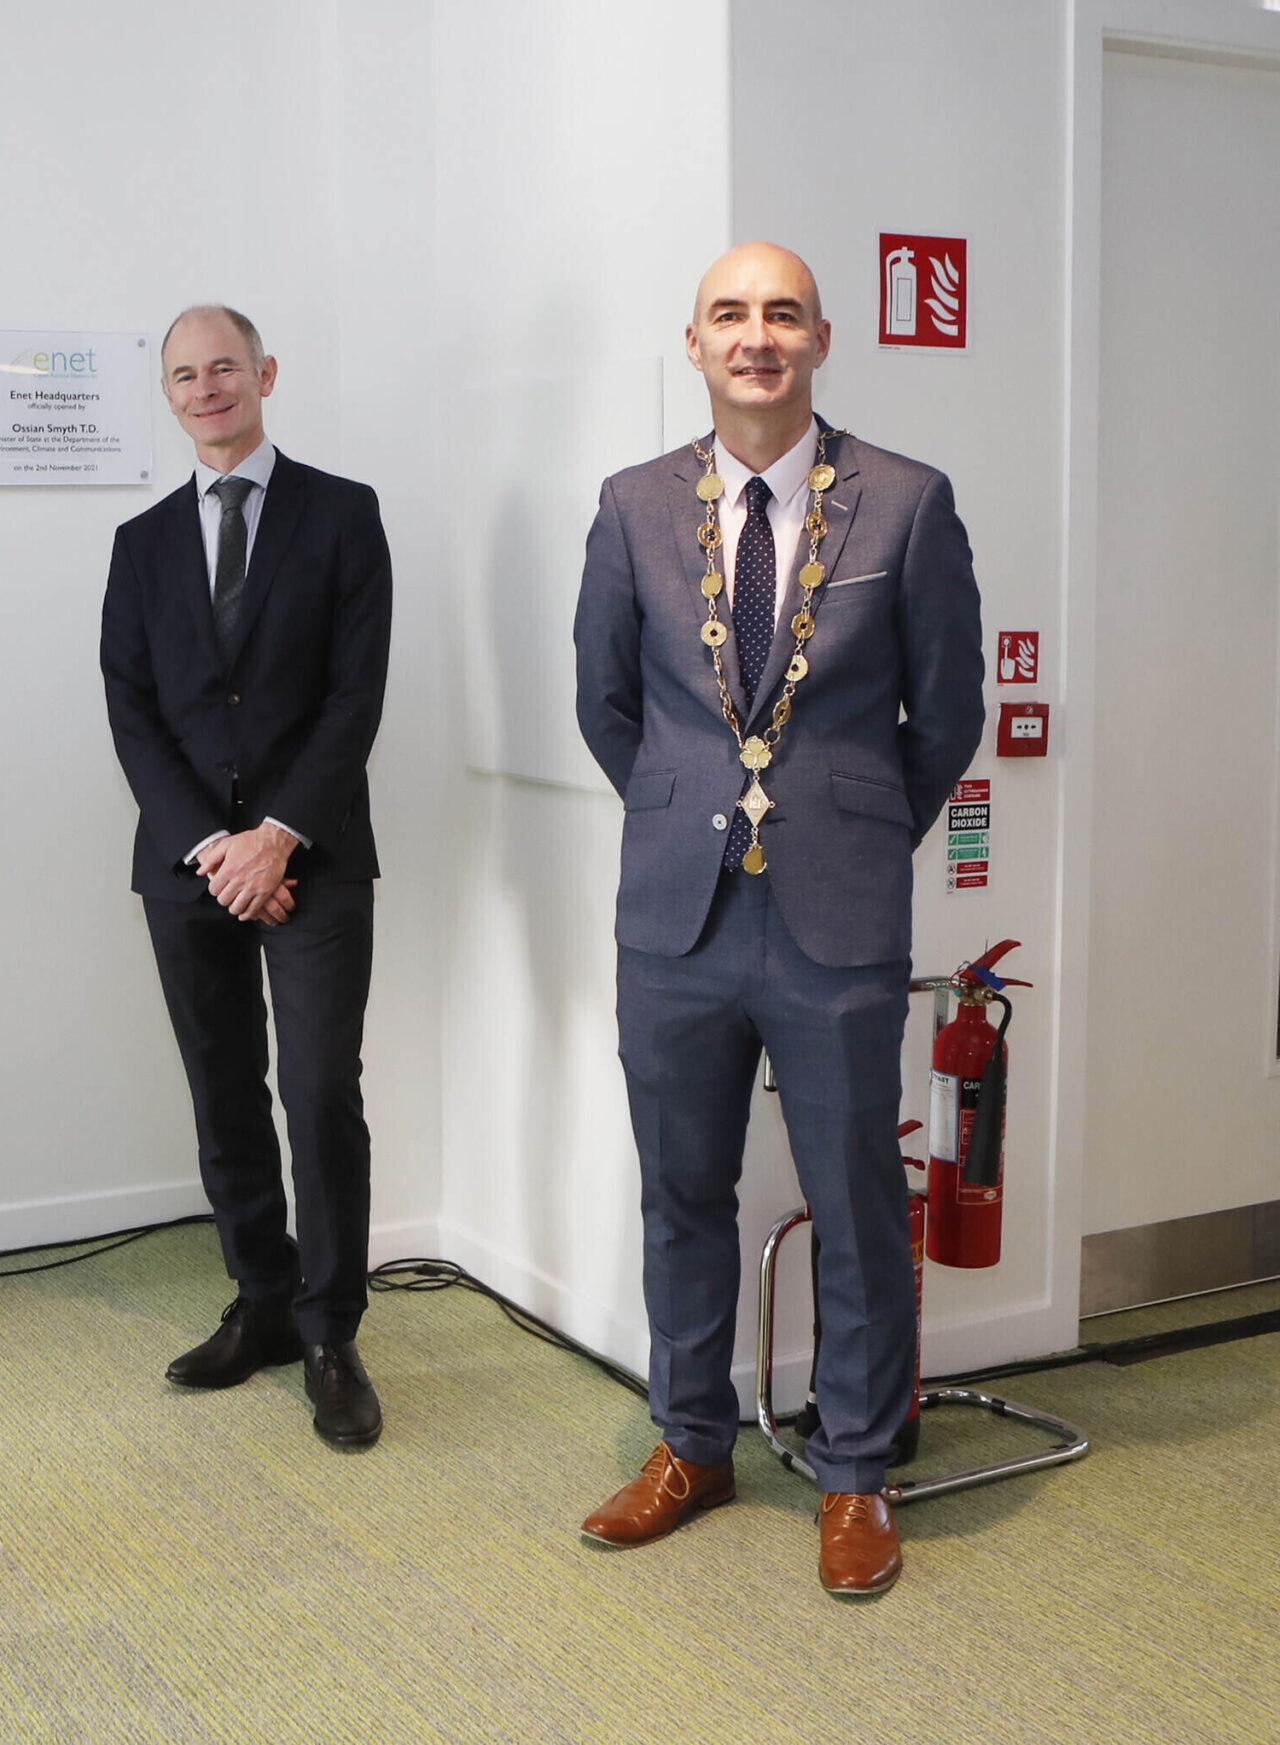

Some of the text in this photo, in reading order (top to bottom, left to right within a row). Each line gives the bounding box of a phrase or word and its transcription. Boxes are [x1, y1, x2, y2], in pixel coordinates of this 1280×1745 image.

[33, 349, 98, 372] enet
[10, 390, 100, 403] Enet Headquarters
[27, 402, 52, 411] officially
[78, 404, 86, 412] by
[12, 423, 100, 436] Ossian Smyth T.D.
[63, 436, 100, 444] Department
[70, 445, 121, 453] Communications
[36, 464, 47, 472] 2nd
[49, 464, 82, 472] November
[83, 464, 98, 472] 2021
[951, 806, 988, 818] CARBON
[951, 818, 988, 828] DIOXIDE
